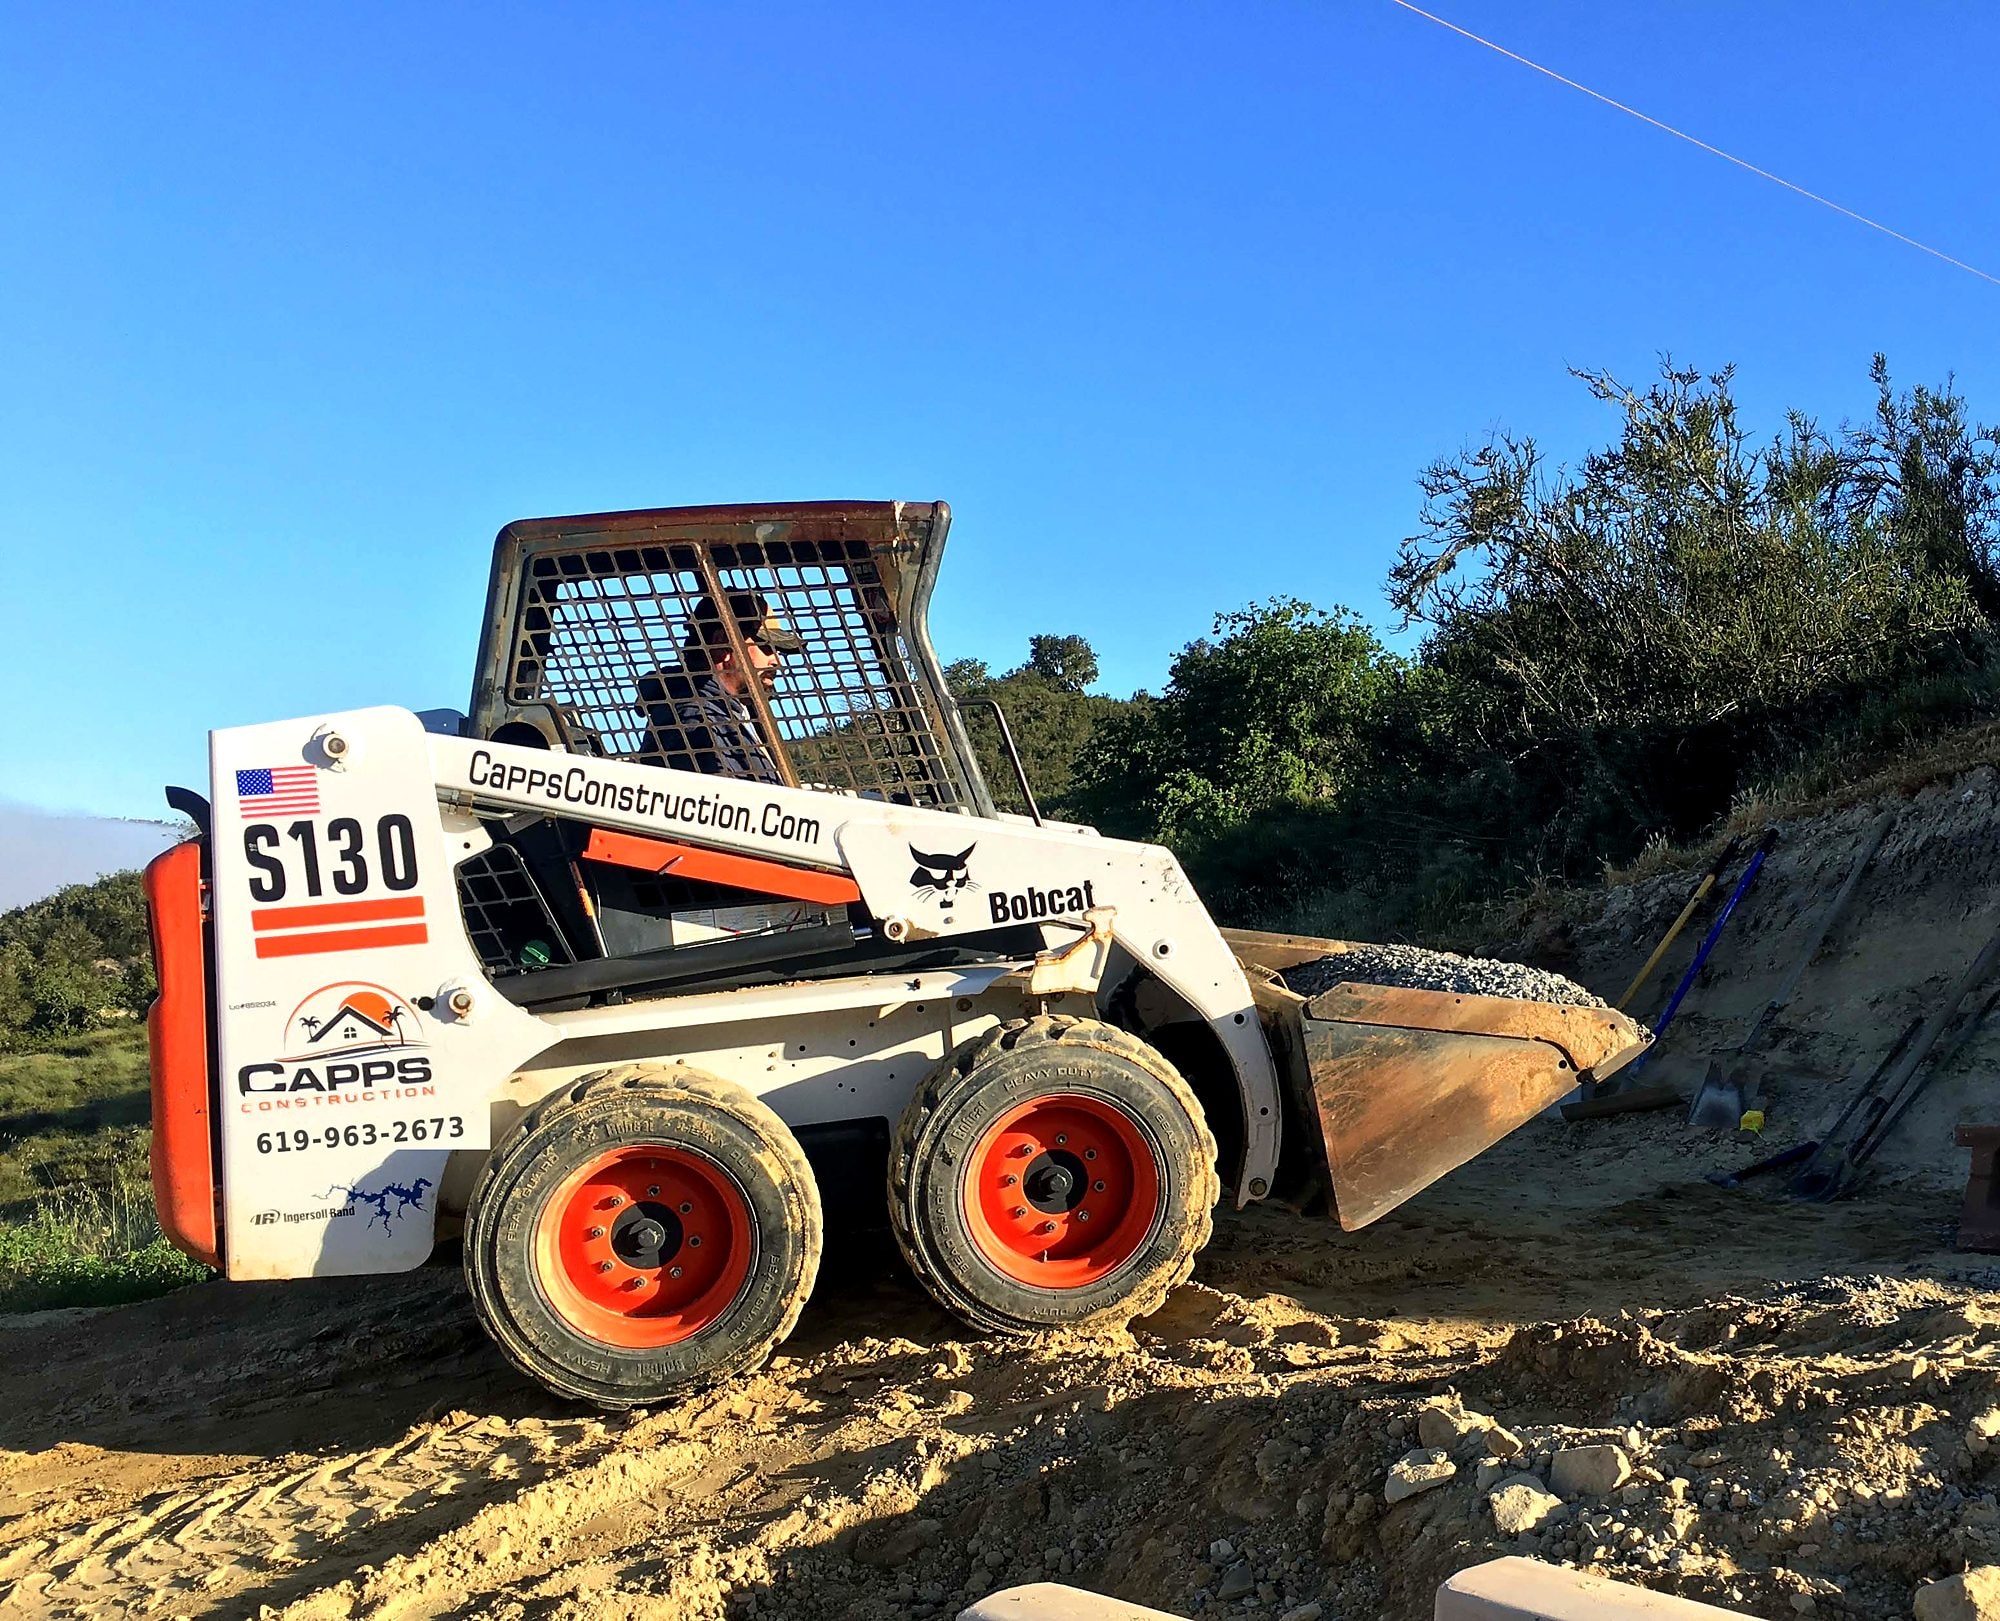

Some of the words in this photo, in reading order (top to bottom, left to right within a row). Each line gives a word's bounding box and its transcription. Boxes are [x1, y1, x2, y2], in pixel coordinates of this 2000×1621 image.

[469, 750, 820, 844] CappsConstruction.Com
[244, 813, 418, 902] S130
[989, 880, 1096, 924] Bobcat
[238, 1057, 433, 1097] CAPPS
[1003, 1068, 1051, 1092] HEAVY
[1056, 1066, 1095, 1079] DUTY
[241, 1085, 436, 1113] CONSTRUCTION
[256, 1116, 465, 1154] 619-963-2673
[951, 1100, 988, 1141] Bobcat
[1155, 1113, 1178, 1148] BEAD
[283, 1208, 328, 1224] Ingersoll
[330, 1206, 356, 1218] Rand
[507, 1201, 526, 1241] BEAD
[761, 1254, 781, 1294] BEAD
[944, 1239, 970, 1274] BEAD
[728, 1296, 767, 1340] GUARD
